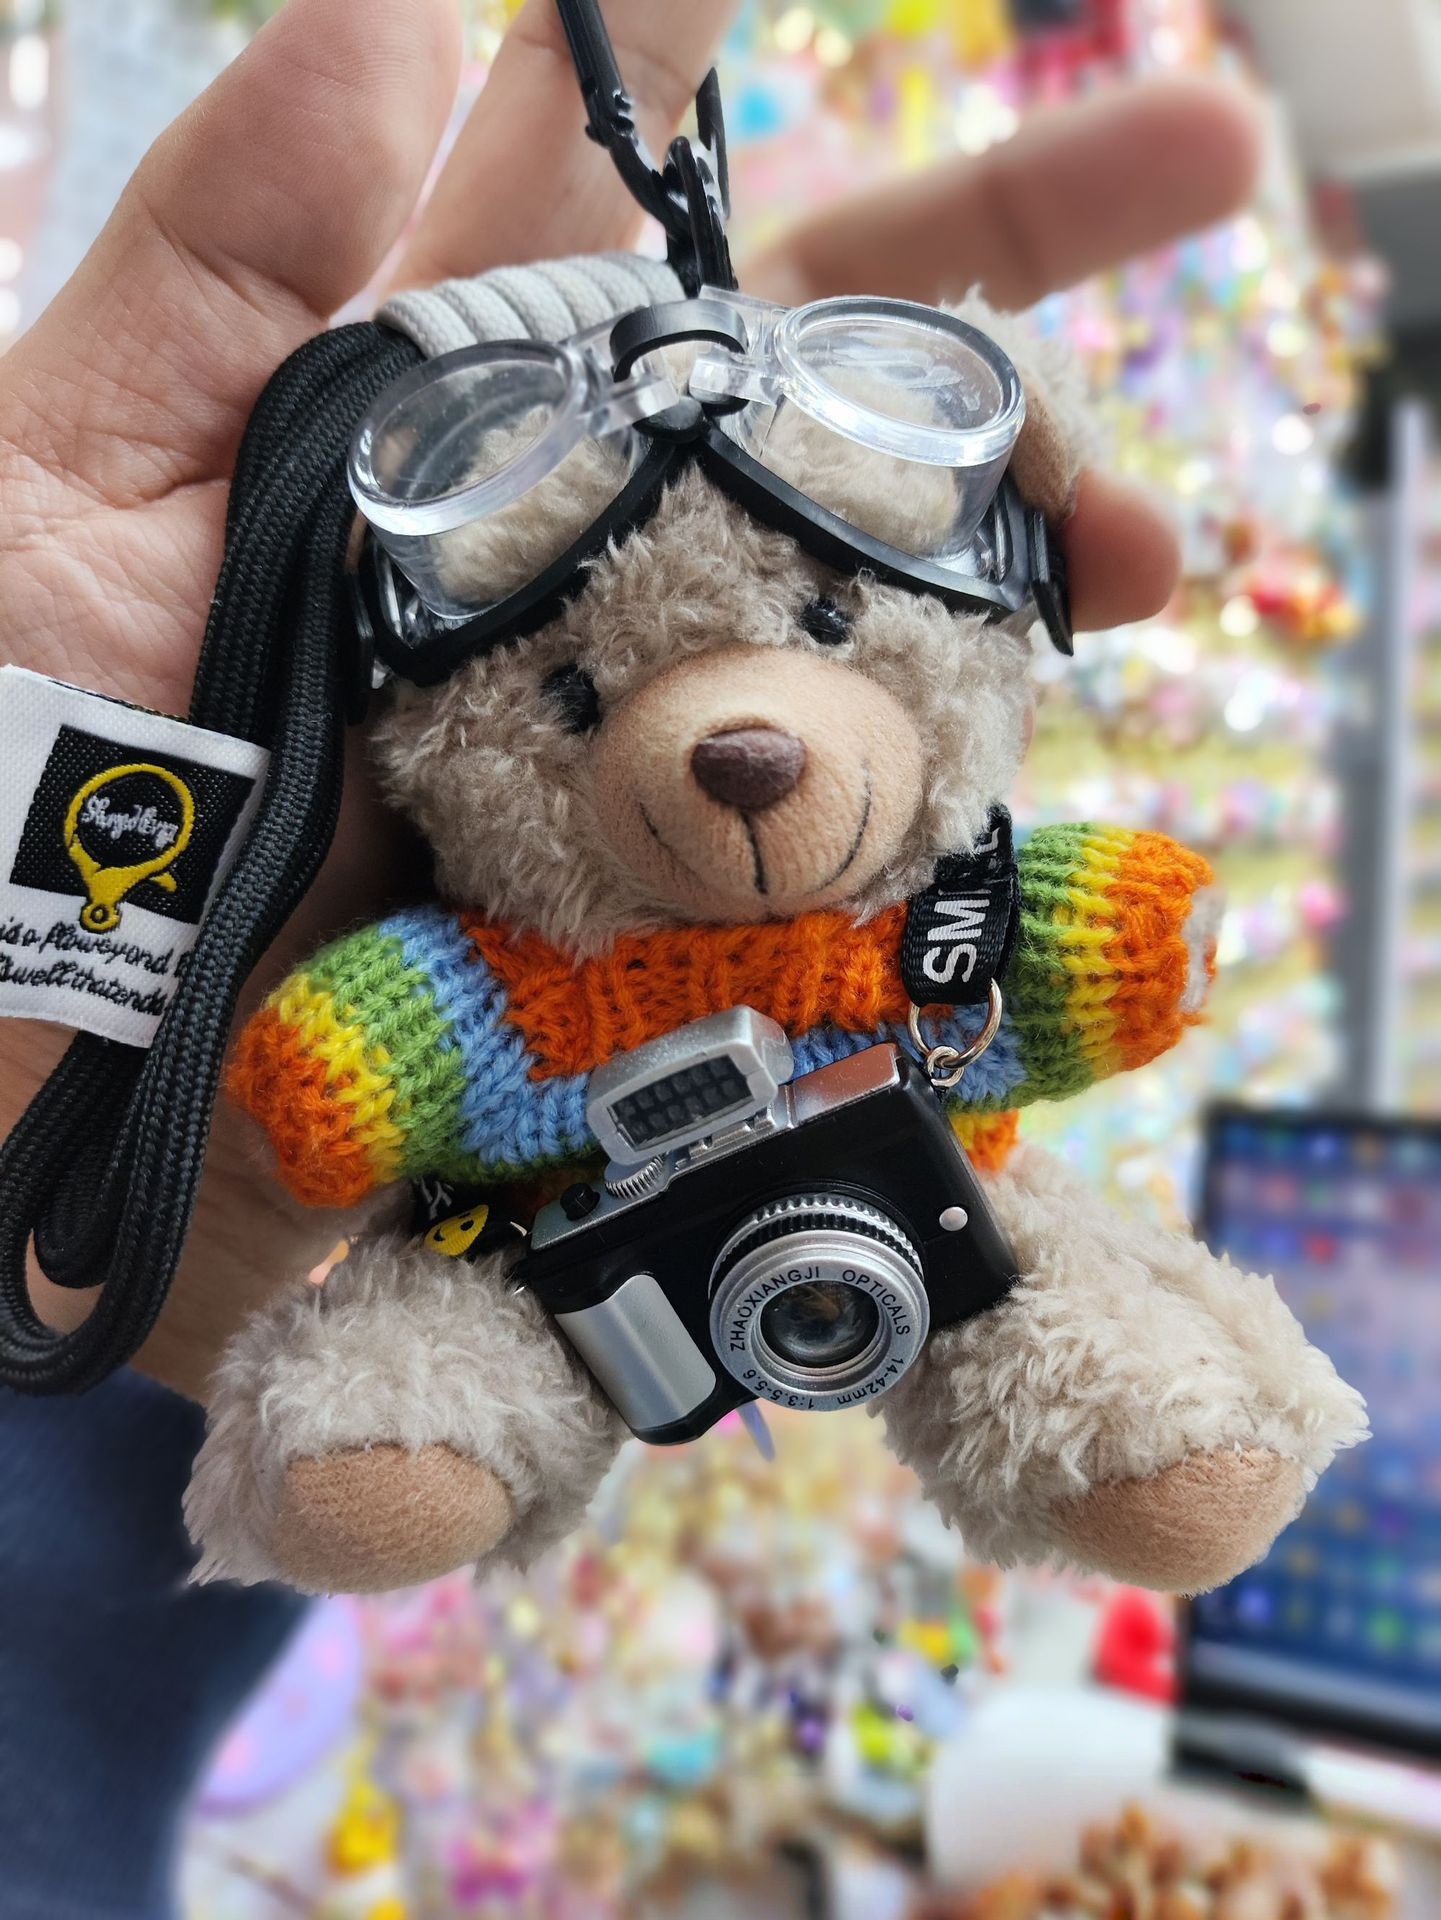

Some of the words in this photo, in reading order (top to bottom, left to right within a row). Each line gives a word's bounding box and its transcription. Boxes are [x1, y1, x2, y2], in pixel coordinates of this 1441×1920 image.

[730, 1266, 820, 1352] ZHAOXIANGJI
[842, 1269, 910, 1335] OPTICALS
[743, 1369, 814, 1409] 1:3.5-5.6
[837, 1357, 905, 1405] 14-42mm
